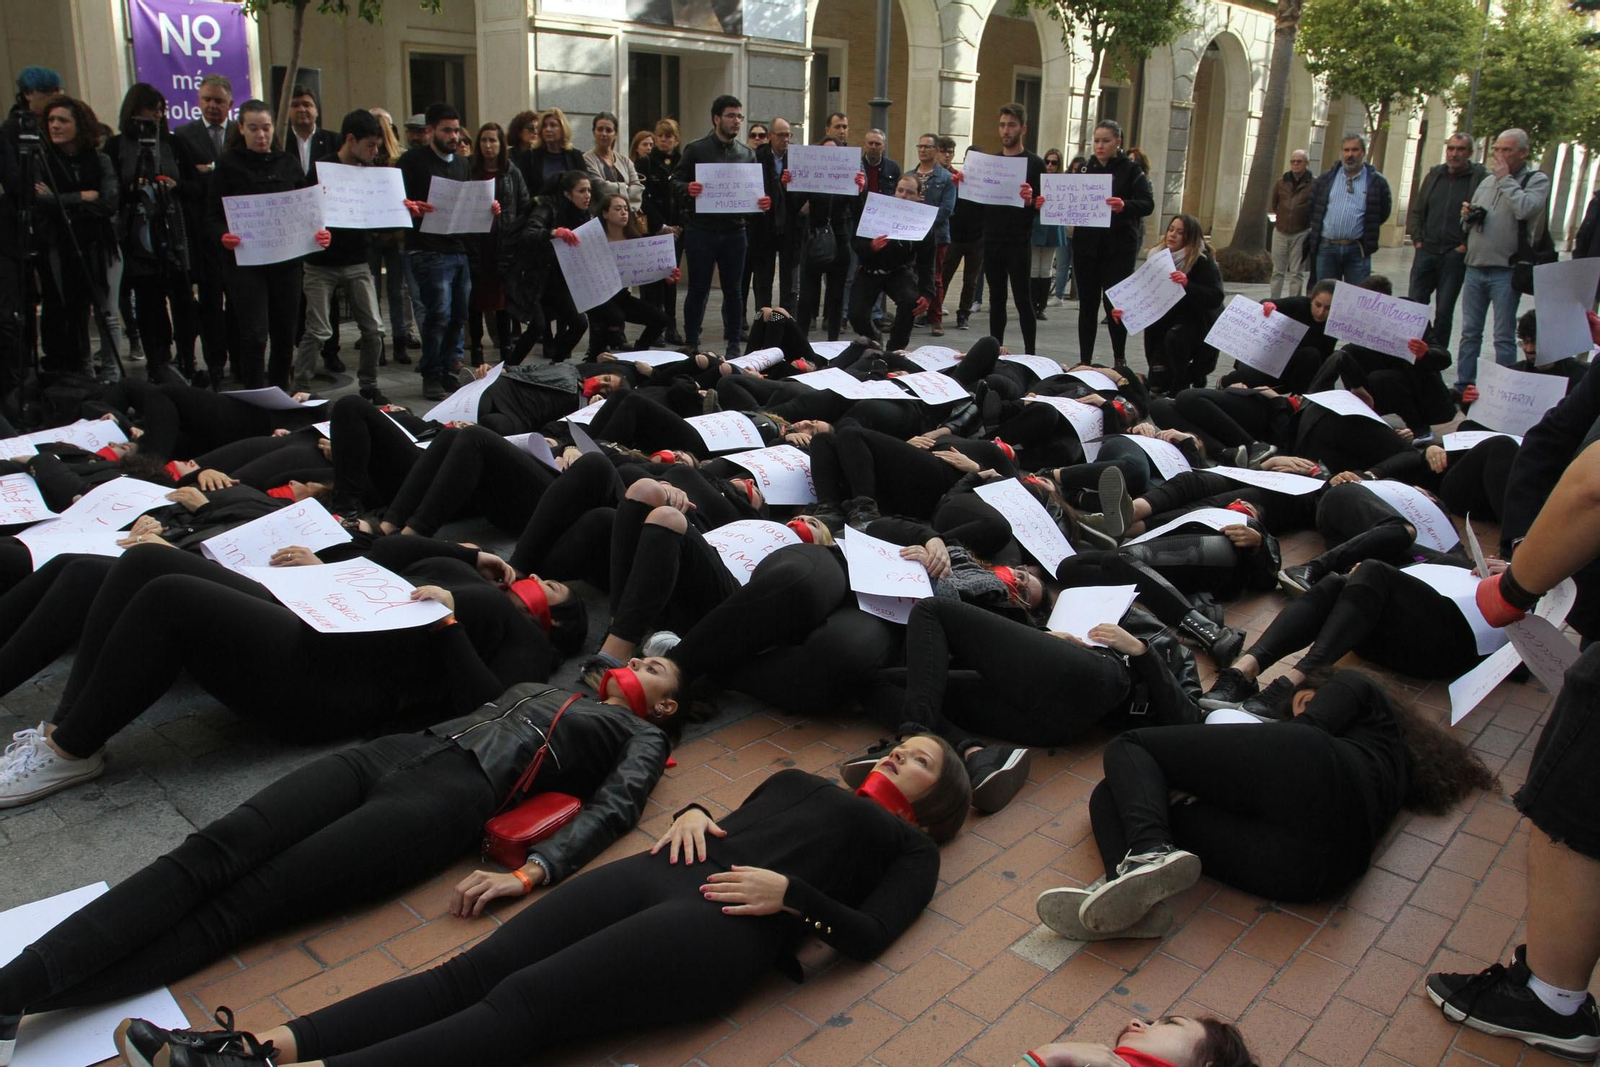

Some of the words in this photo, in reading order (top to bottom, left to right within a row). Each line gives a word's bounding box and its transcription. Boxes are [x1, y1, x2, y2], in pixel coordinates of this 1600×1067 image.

[158, 12, 221, 65] NO
[172, 70, 205, 90] má
[1044, 179, 1051, 190] A
[715, 200, 751, 208] MUJERES
[1069, 193, 1078, 203] DE
[269, 207, 287, 218] 773
[1060, 218, 1089, 226] MUJERES
[1222, 312, 1229, 321] y
[1229, 315, 1249, 330] rostro
[1249, 325, 1260, 337] de
[1228, 305, 1257, 324] pobreza
[1260, 319, 1282, 338] tiene
[1486, 384, 1496, 398] ME
[1497, 389, 1536, 407] MATARON
[333, 565, 421, 616] ROSA
